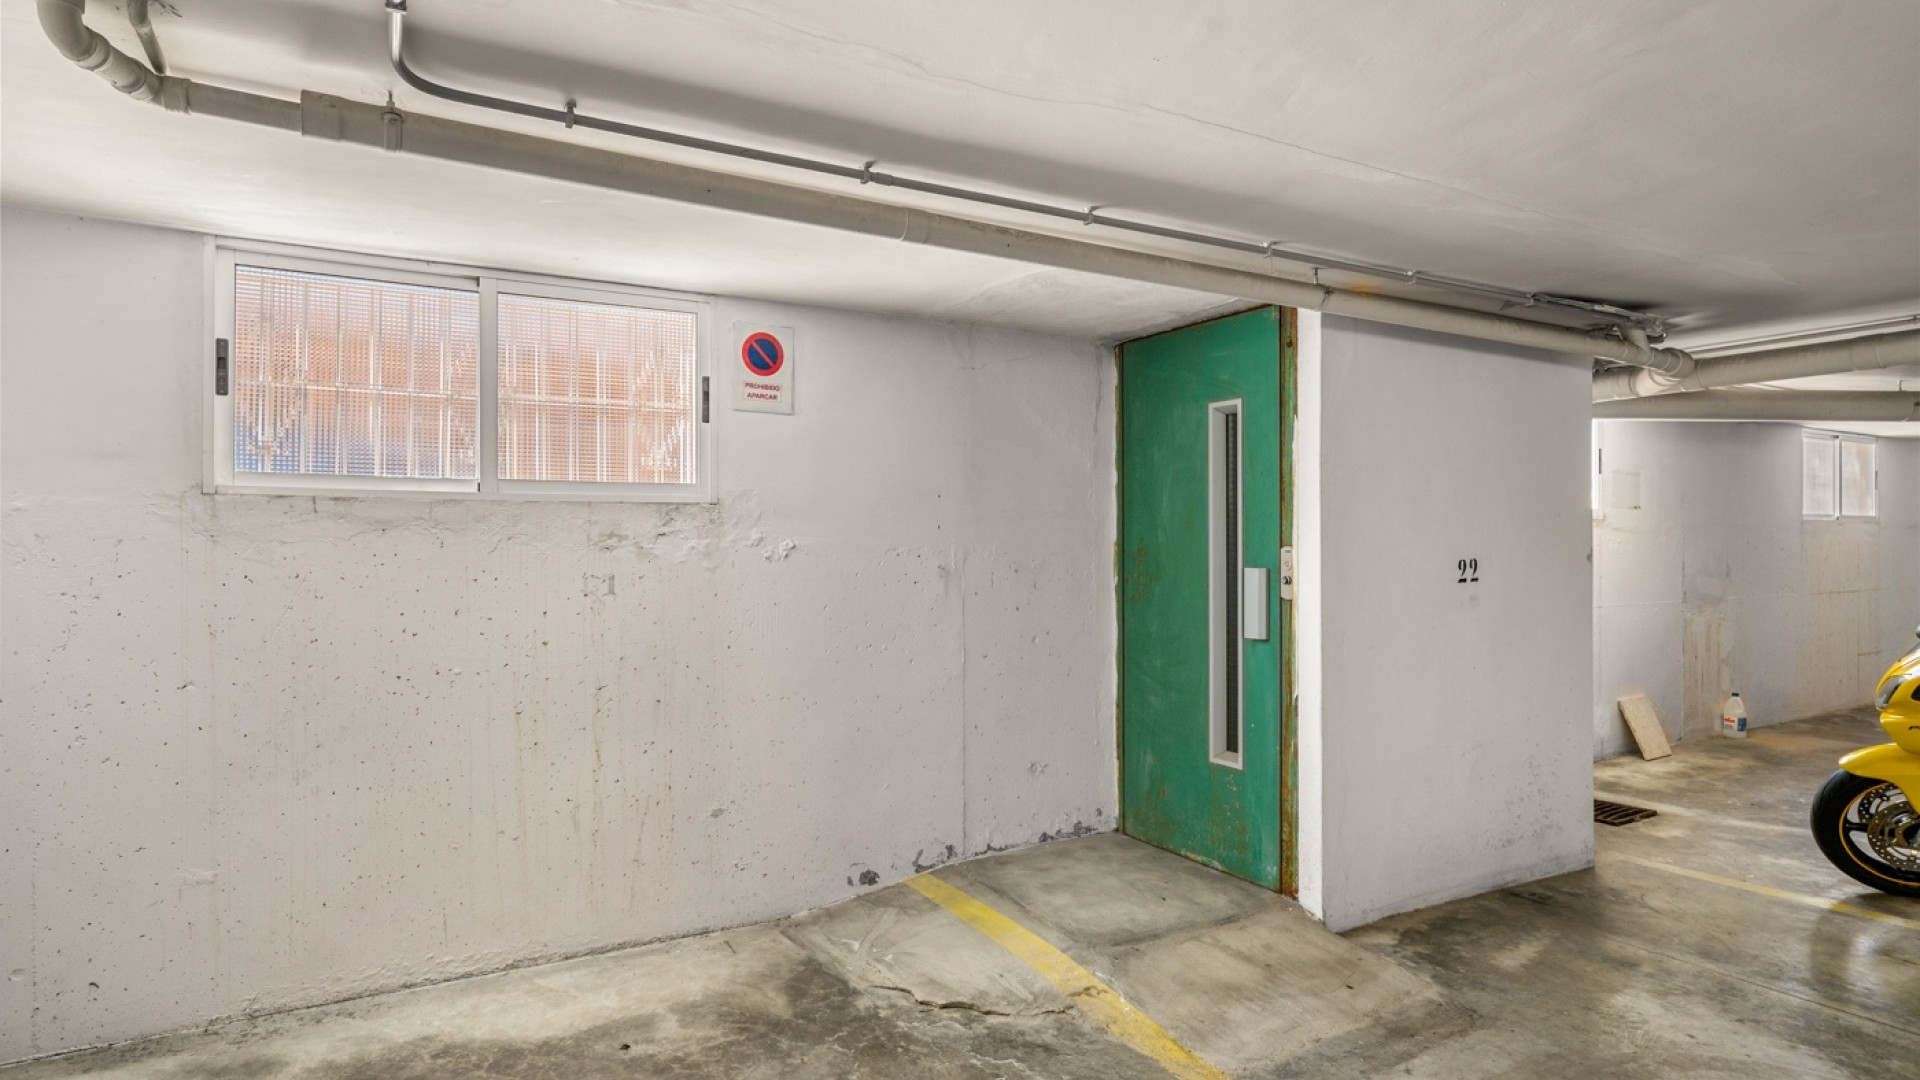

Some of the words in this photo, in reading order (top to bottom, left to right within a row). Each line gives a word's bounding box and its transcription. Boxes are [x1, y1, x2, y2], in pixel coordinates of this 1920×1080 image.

[745, 382, 780, 391] PROHIBIDO
[747, 392, 777, 400] APARCAR
[1457, 558, 1479, 583] 22
